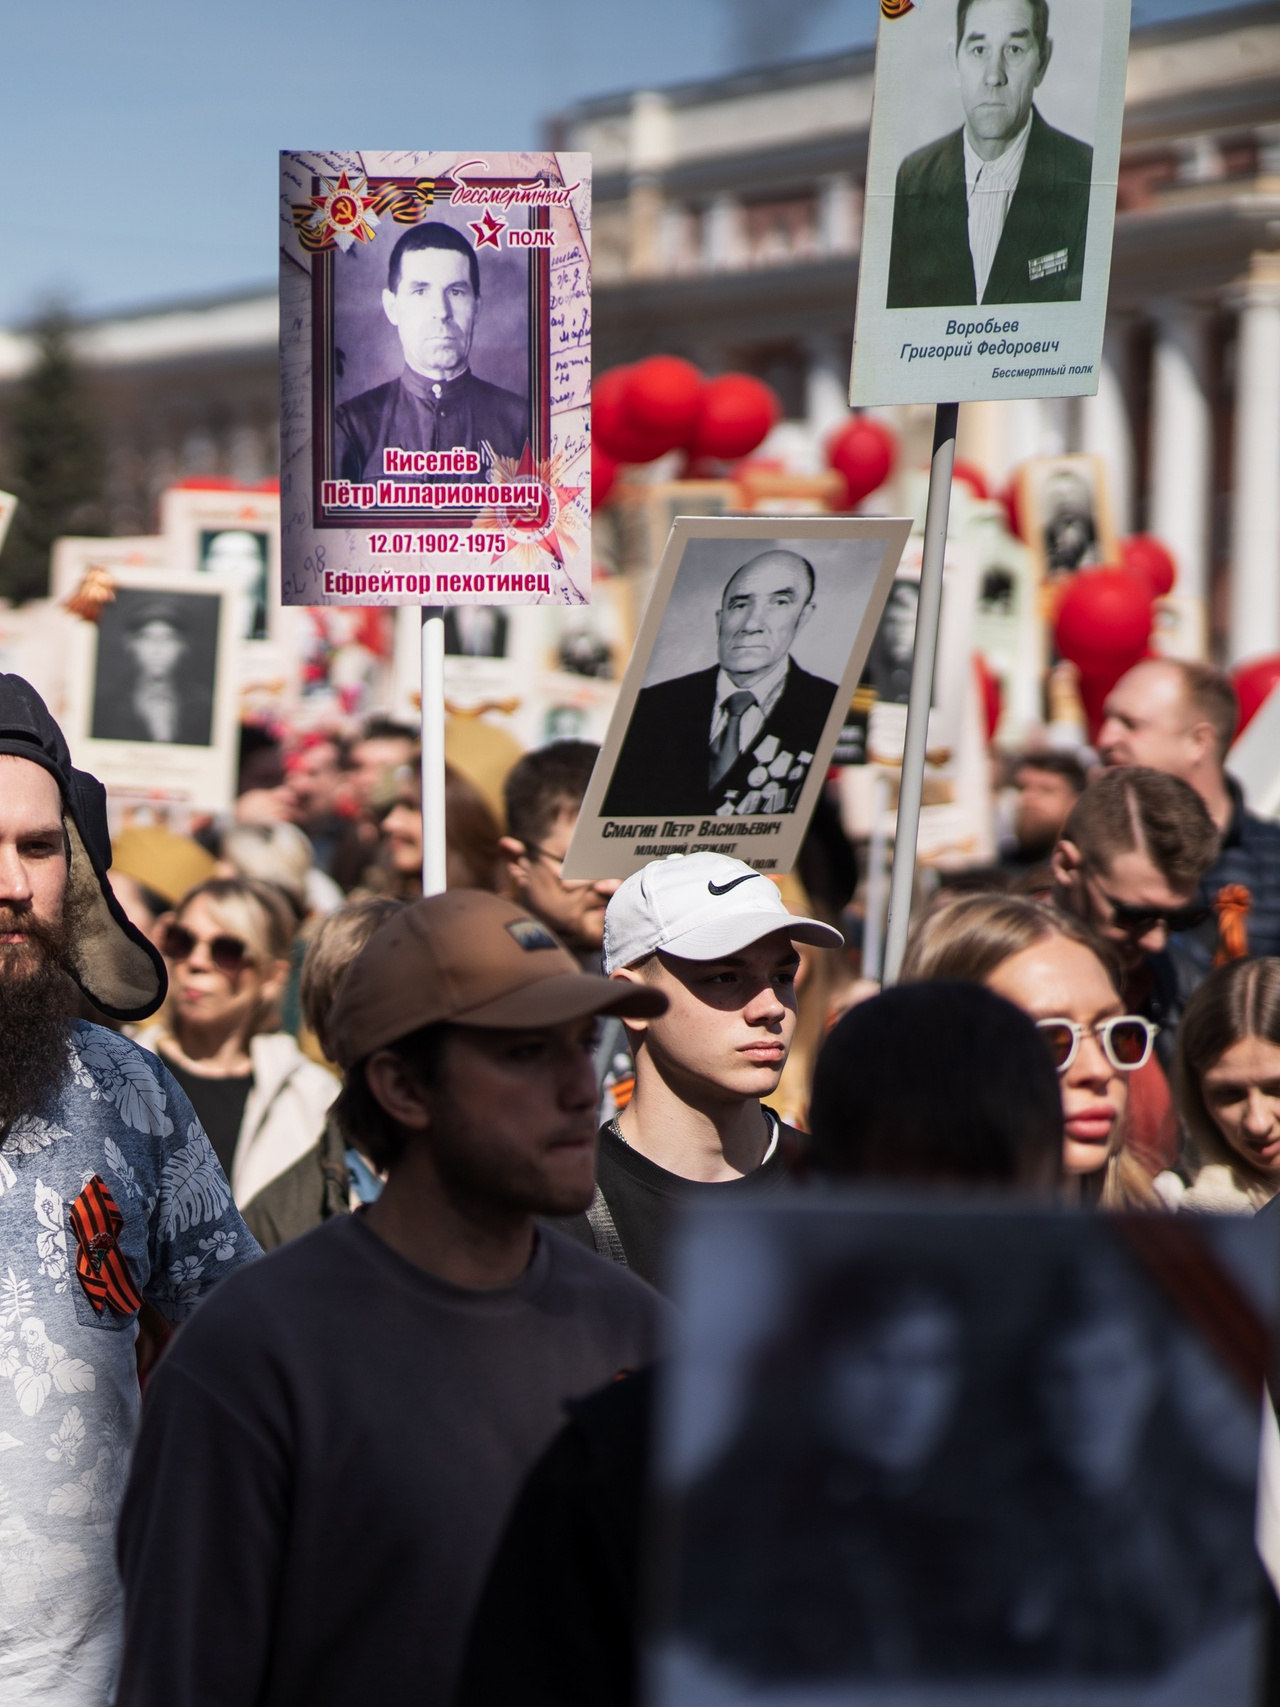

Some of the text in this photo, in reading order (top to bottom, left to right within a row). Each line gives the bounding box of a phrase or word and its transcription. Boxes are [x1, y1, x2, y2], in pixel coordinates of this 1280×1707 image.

[452, 160, 580, 211] бессмертный
[945, 318, 1019, 338] Воробьев
[900, 339, 1059, 362] Григорий Федорович
[992, 364, 1094, 379] Бессмертный полк
[384, 449, 479, 473] Киселёв
[323, 482, 374, 506] Пётр
[380, 482, 539, 506] Илларионович
[368, 534, 506, 553] 12.07.1902-1975
[324, 570, 430, 595] Ефрейтор
[436, 573, 550, 594] пехотинец
